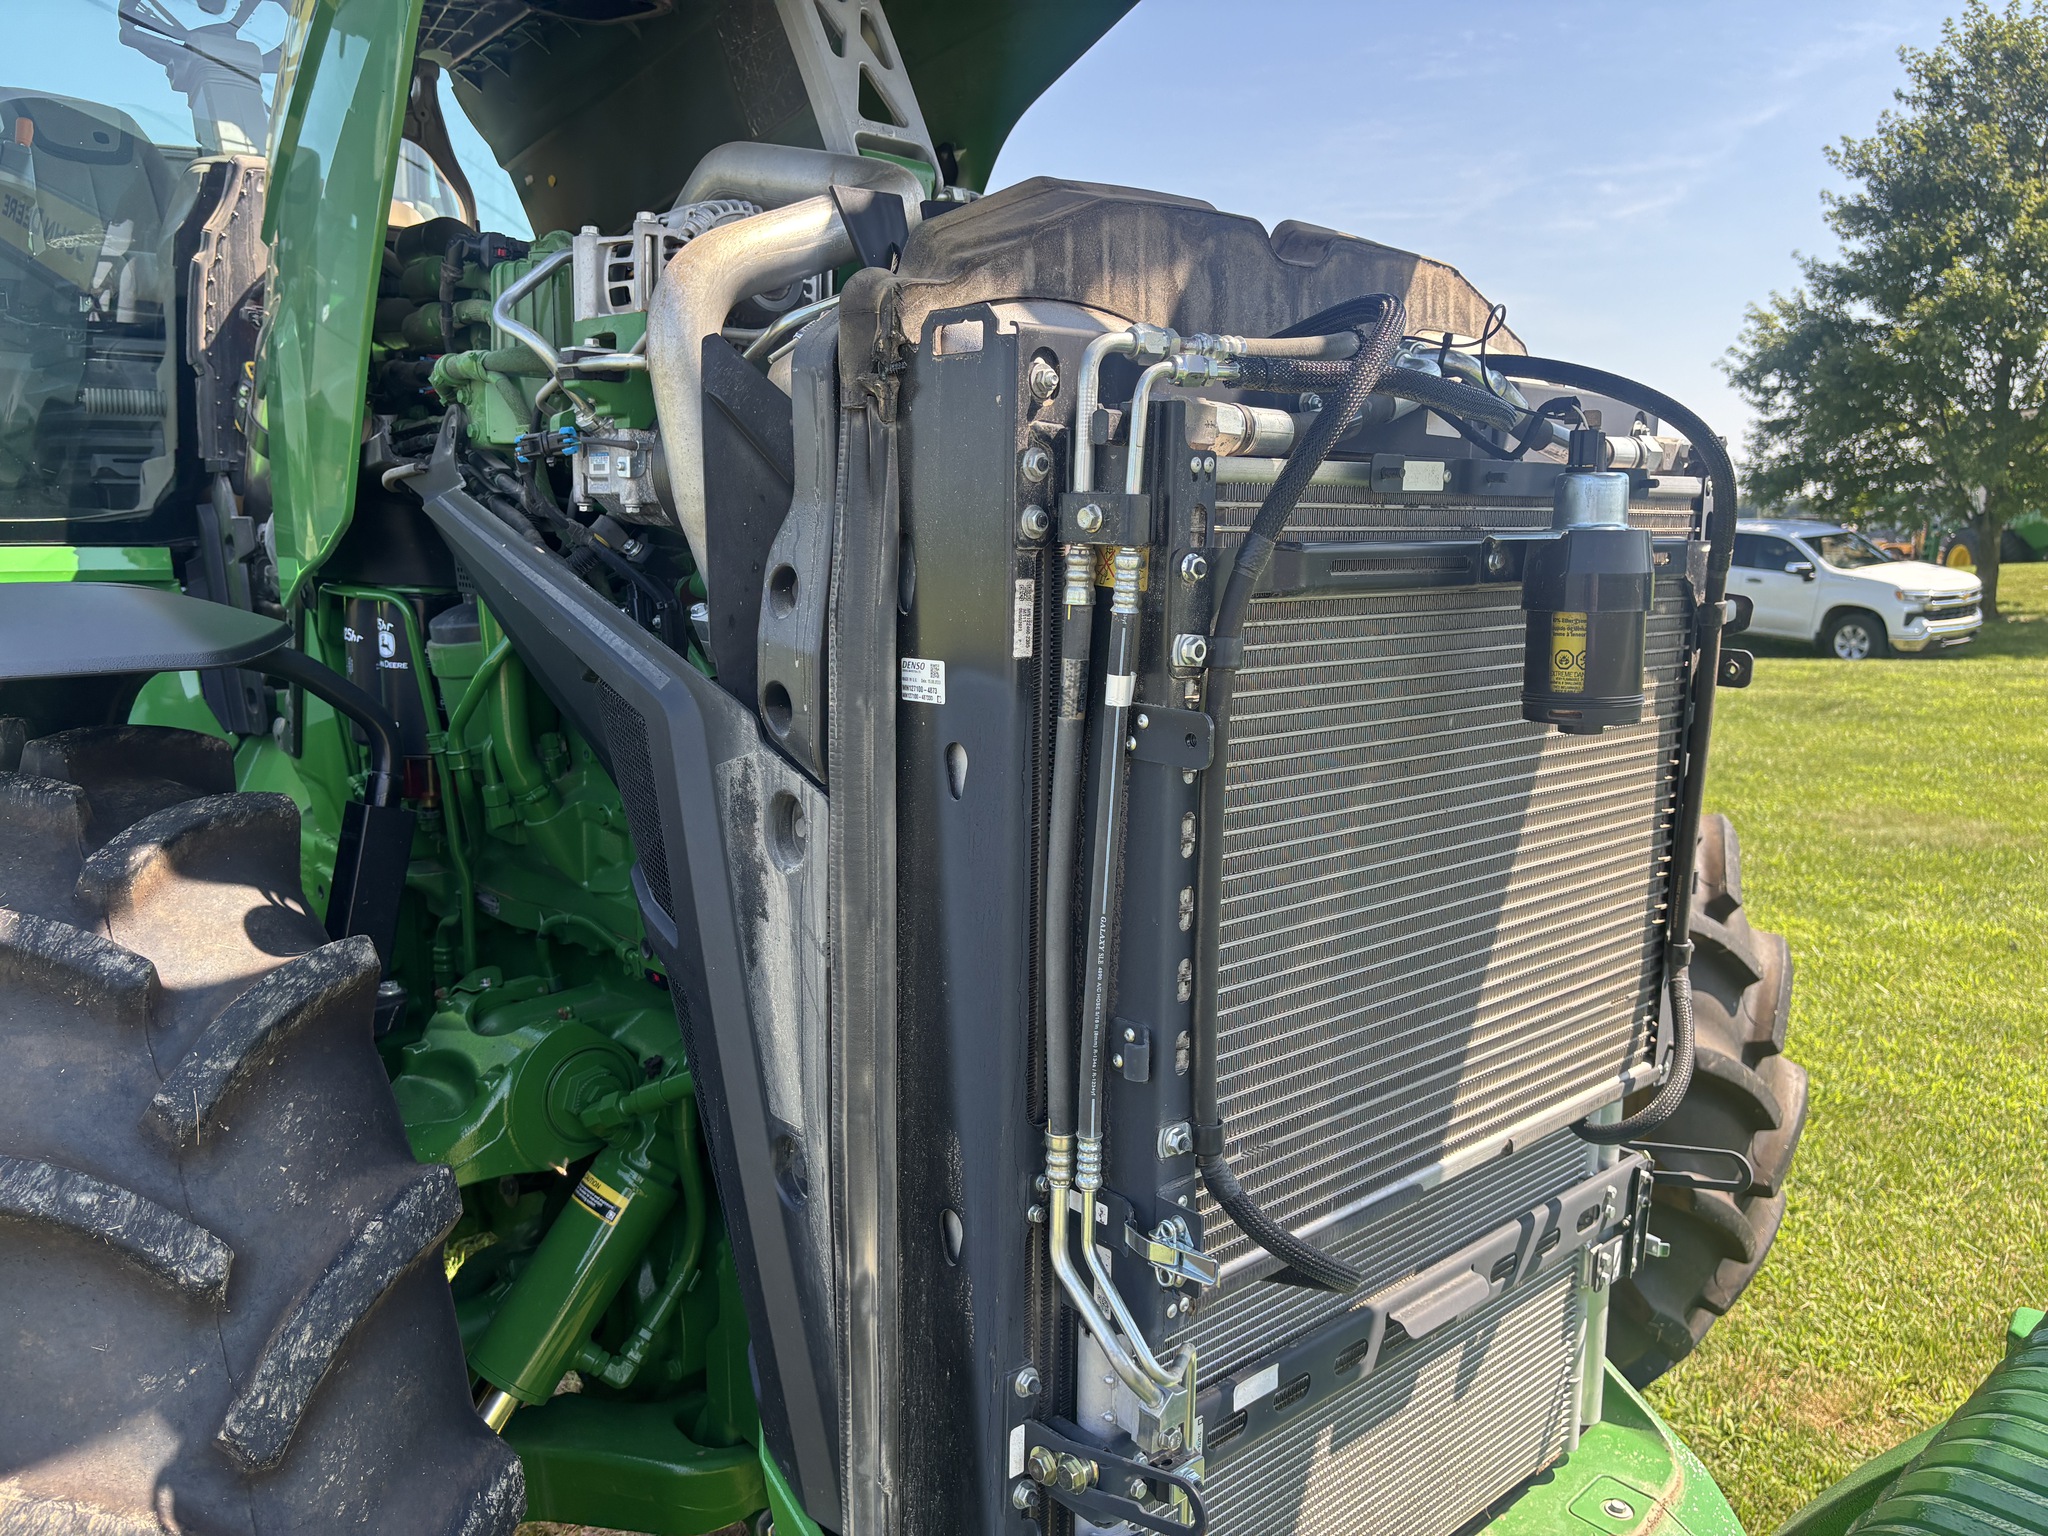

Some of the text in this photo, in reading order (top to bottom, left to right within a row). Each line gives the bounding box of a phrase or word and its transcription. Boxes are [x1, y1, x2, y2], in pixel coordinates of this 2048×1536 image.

[902, 660, 926, 671] DENSO
[1098, 916, 1107, 952] GALAXY
[583, 1172, 602, 1190] AUTION
